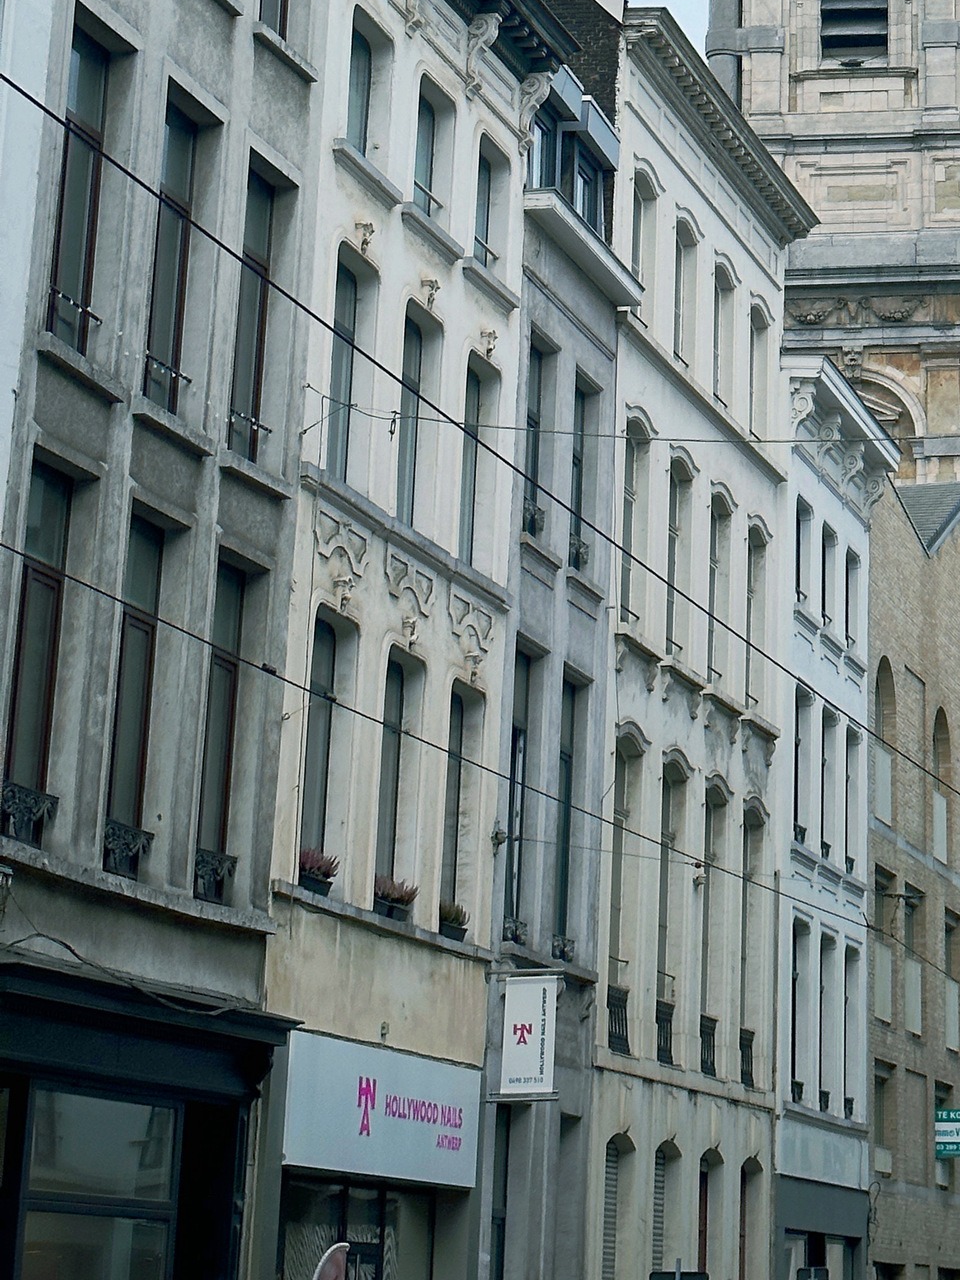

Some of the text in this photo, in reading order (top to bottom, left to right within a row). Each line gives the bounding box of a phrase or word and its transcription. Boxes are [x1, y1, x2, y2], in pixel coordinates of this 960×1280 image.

[384, 1094, 463, 1129] HOLLYWOOD NAILS
[937, 1111, 948, 1119] TE
[436, 1134, 462, 1151] ANTWERP
